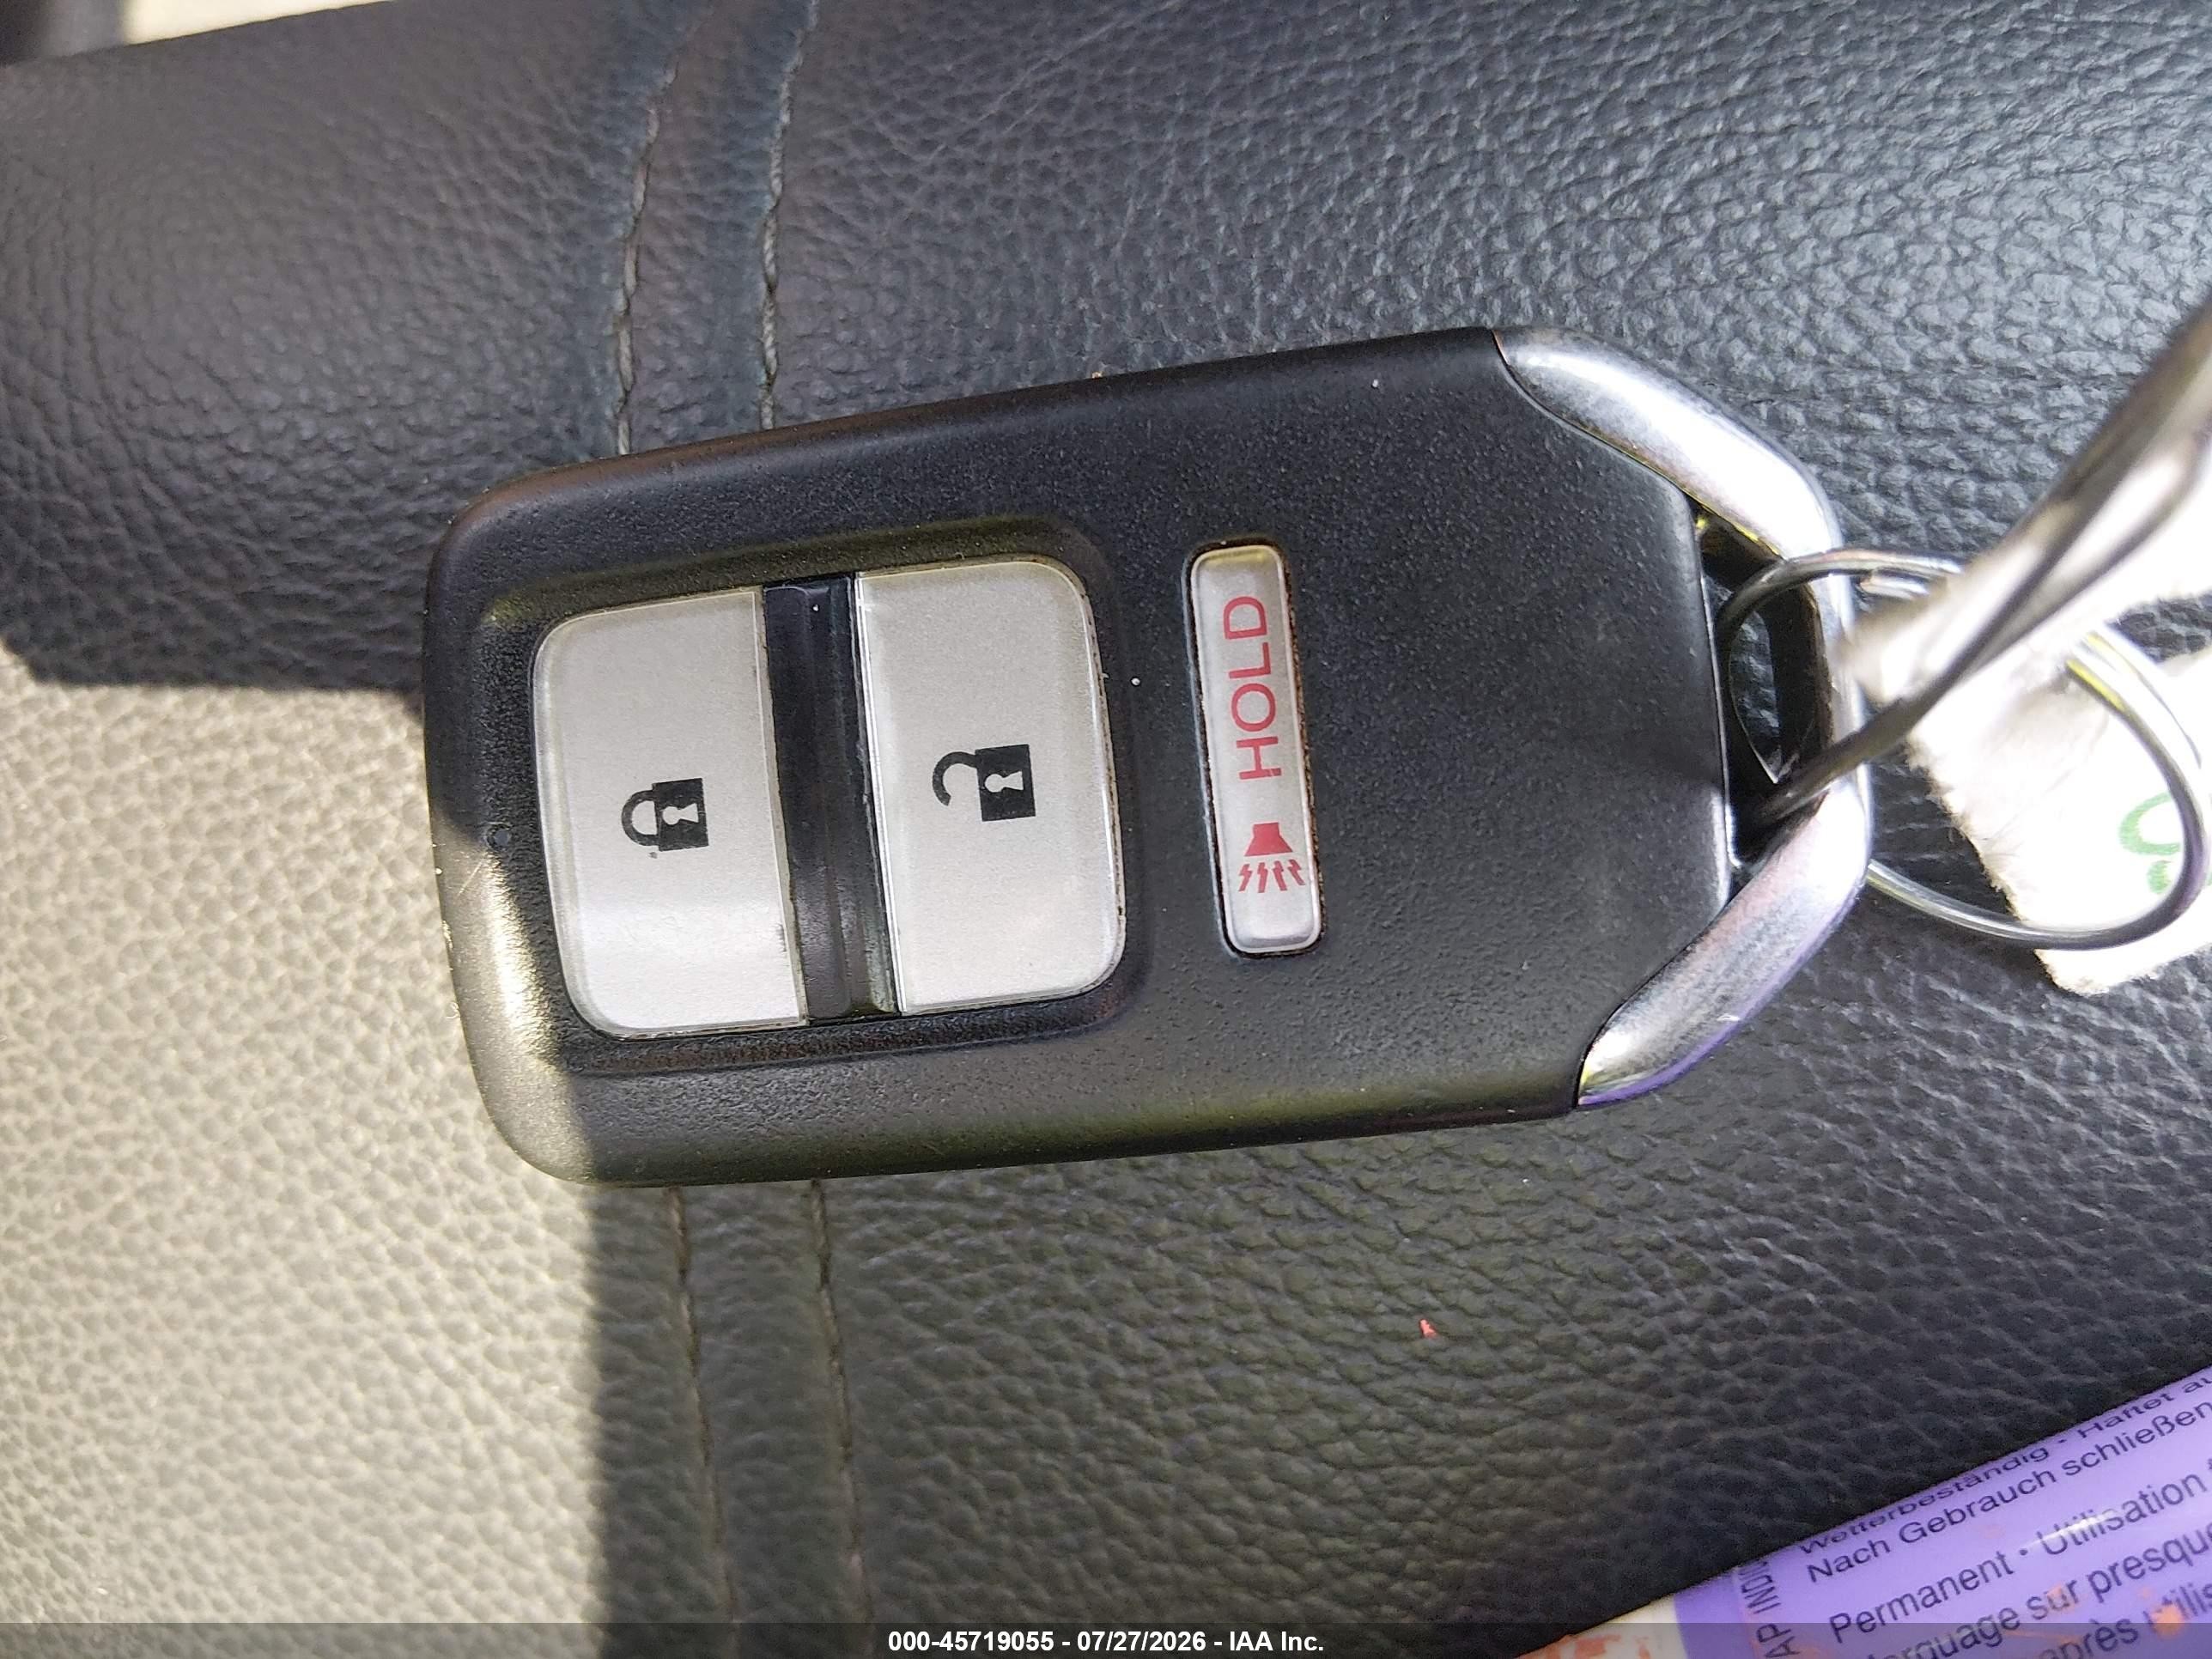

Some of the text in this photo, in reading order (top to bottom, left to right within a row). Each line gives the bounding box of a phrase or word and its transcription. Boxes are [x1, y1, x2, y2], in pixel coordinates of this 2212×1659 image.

[1223, 596, 1280, 780] HOLD
[1807, 1540, 1891, 1583] Nach
[1898, 1470, 2057, 1544] Gebrauch
[1829, 1474, 2208, 1644] Permanent Utilisation
[2026, 1579, 2078, 1620] sur
